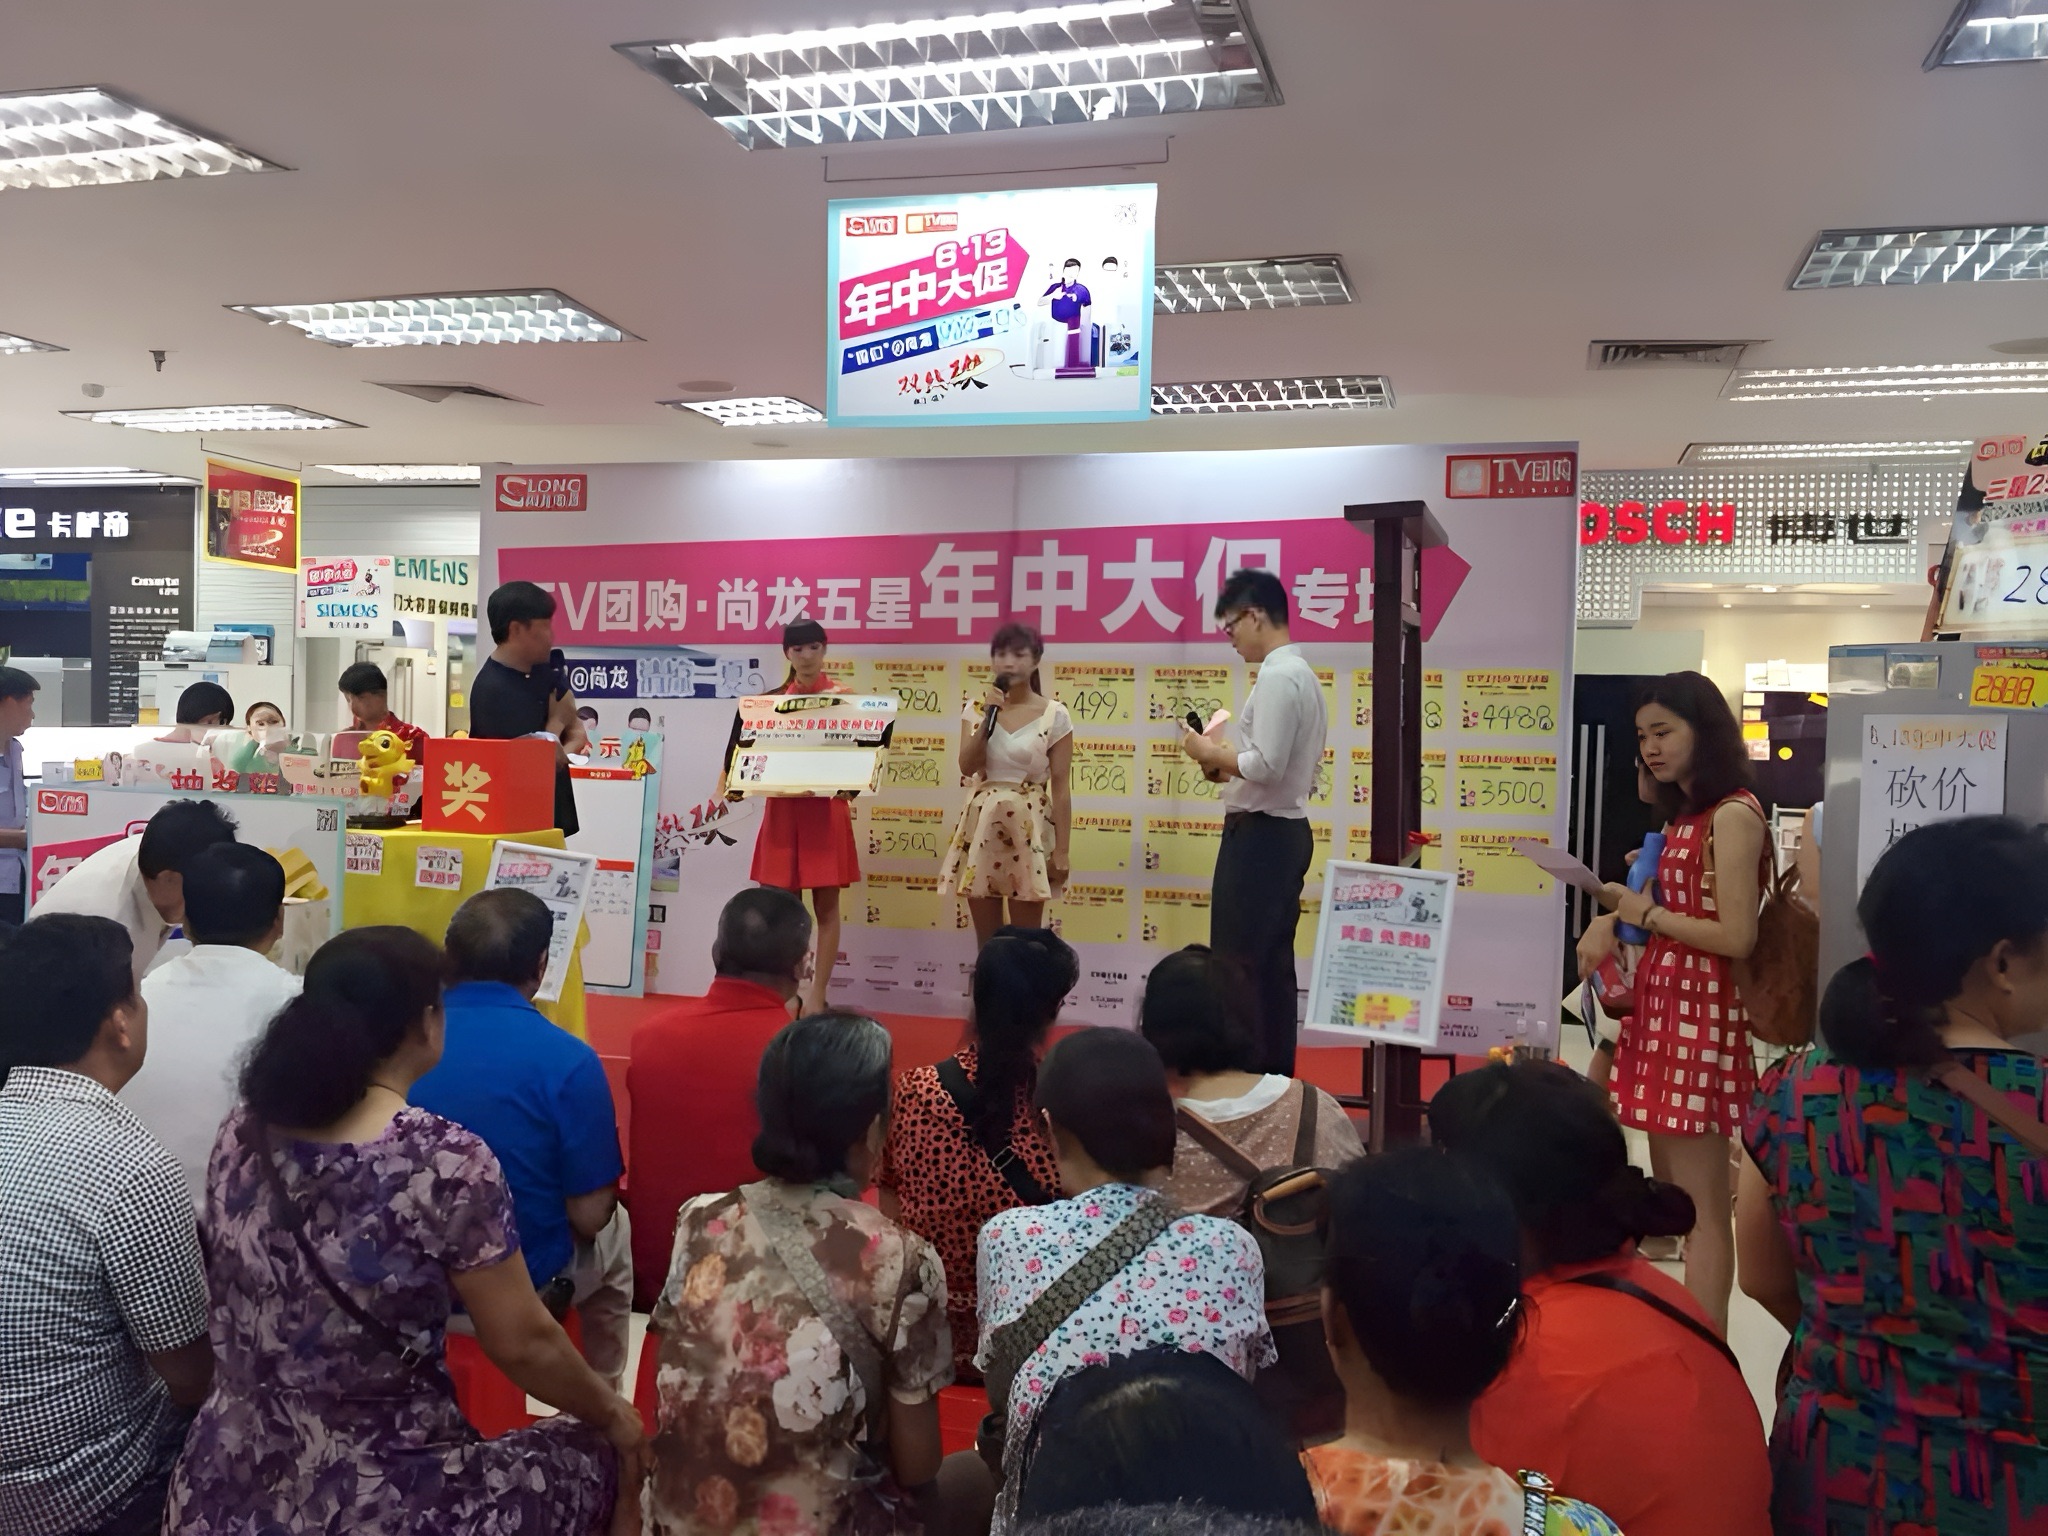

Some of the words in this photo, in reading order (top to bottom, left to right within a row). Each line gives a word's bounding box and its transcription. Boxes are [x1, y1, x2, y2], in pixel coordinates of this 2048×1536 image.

[844, 257, 1009, 327] 年中大促
[441, 761, 492, 822] 奖
[1884, 766, 1978, 813] 砍价
